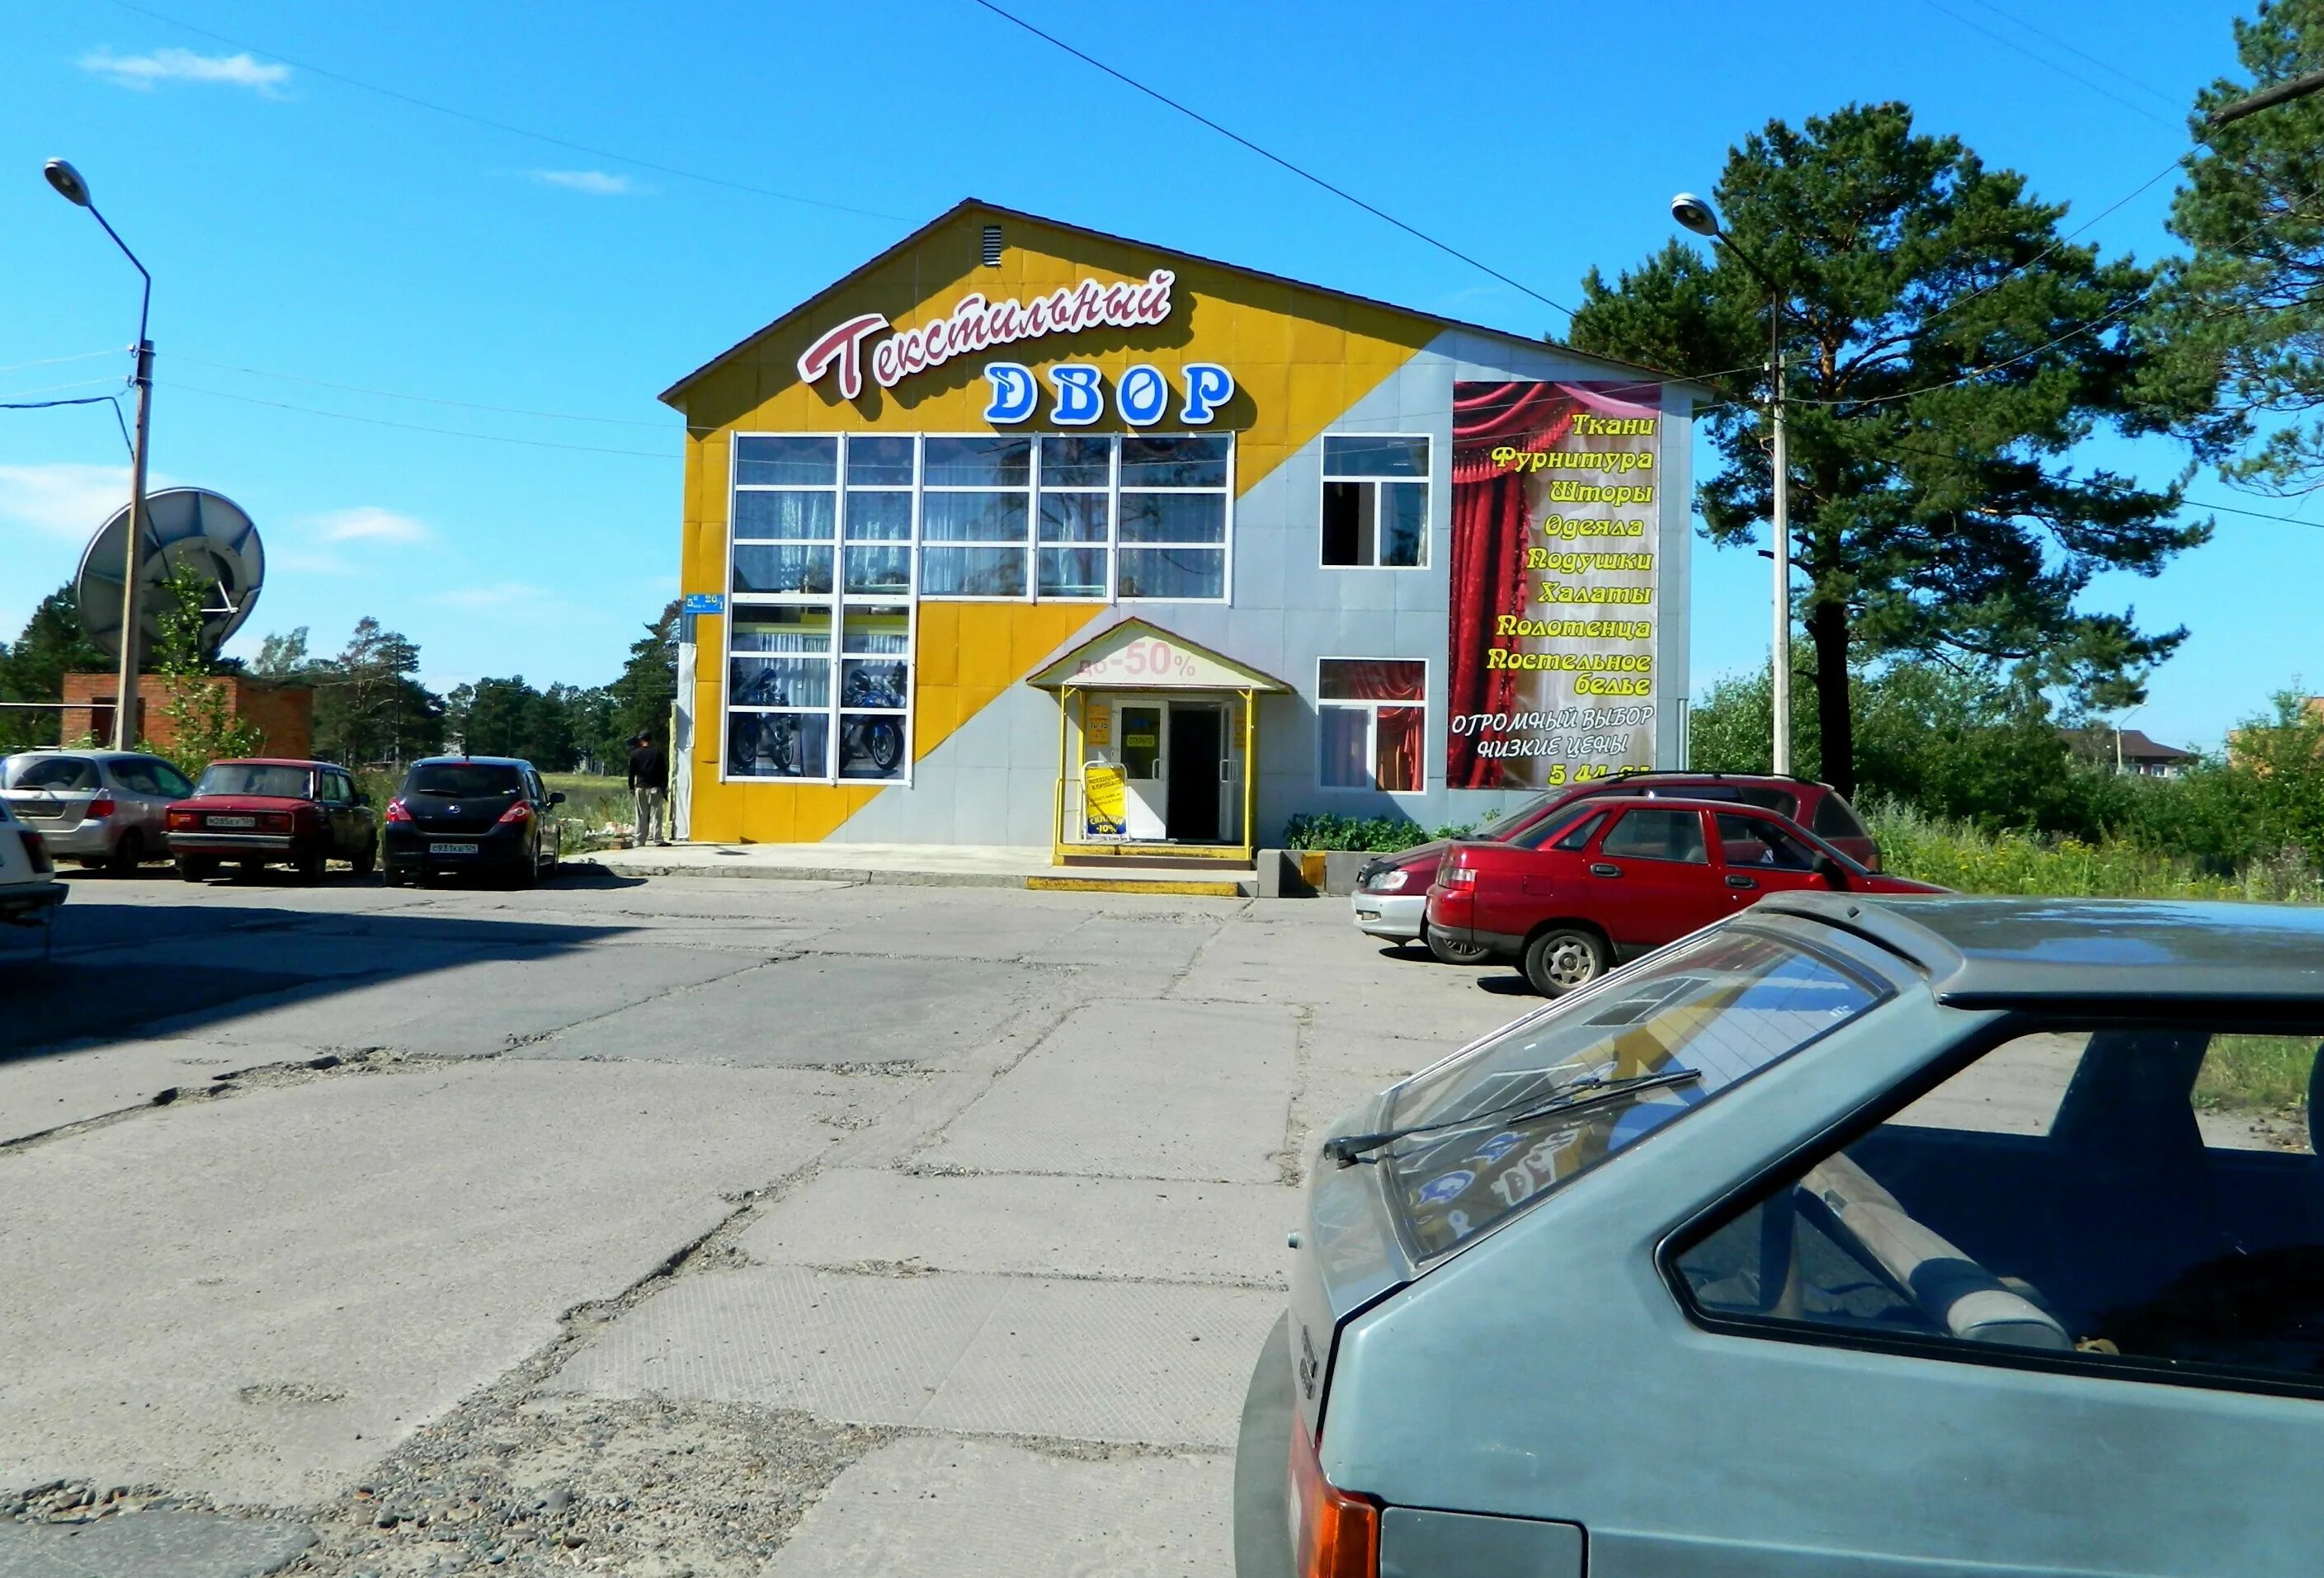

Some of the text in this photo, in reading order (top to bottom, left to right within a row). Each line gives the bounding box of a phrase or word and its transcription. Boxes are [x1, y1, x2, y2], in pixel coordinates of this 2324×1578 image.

[797, 268, 1176, 399] Текстильный
[1571, 413, 1656, 436] Ткани
[1491, 446, 1654, 473] Фурнитура
[1549, 480, 1653, 507] Шторы
[1544, 514, 1644, 540] Одеяла
[1526, 546, 1652, 572] Подушки
[1538, 581, 1652, 605] Халаты
[1495, 614, 1652, 640] Полотенца
[1110, 642, 1195, 677] -50%
[1486, 648, 1652, 671] Постельное
[1574, 672, 1651, 696] белье
[1451, 706, 1655, 737] ОГРОМНЫЙ ВЫБОР
[1477, 734, 1629, 760] НИЗКИЕ ЦЕНЫ
[1547, 764, 1567, 786] 5
